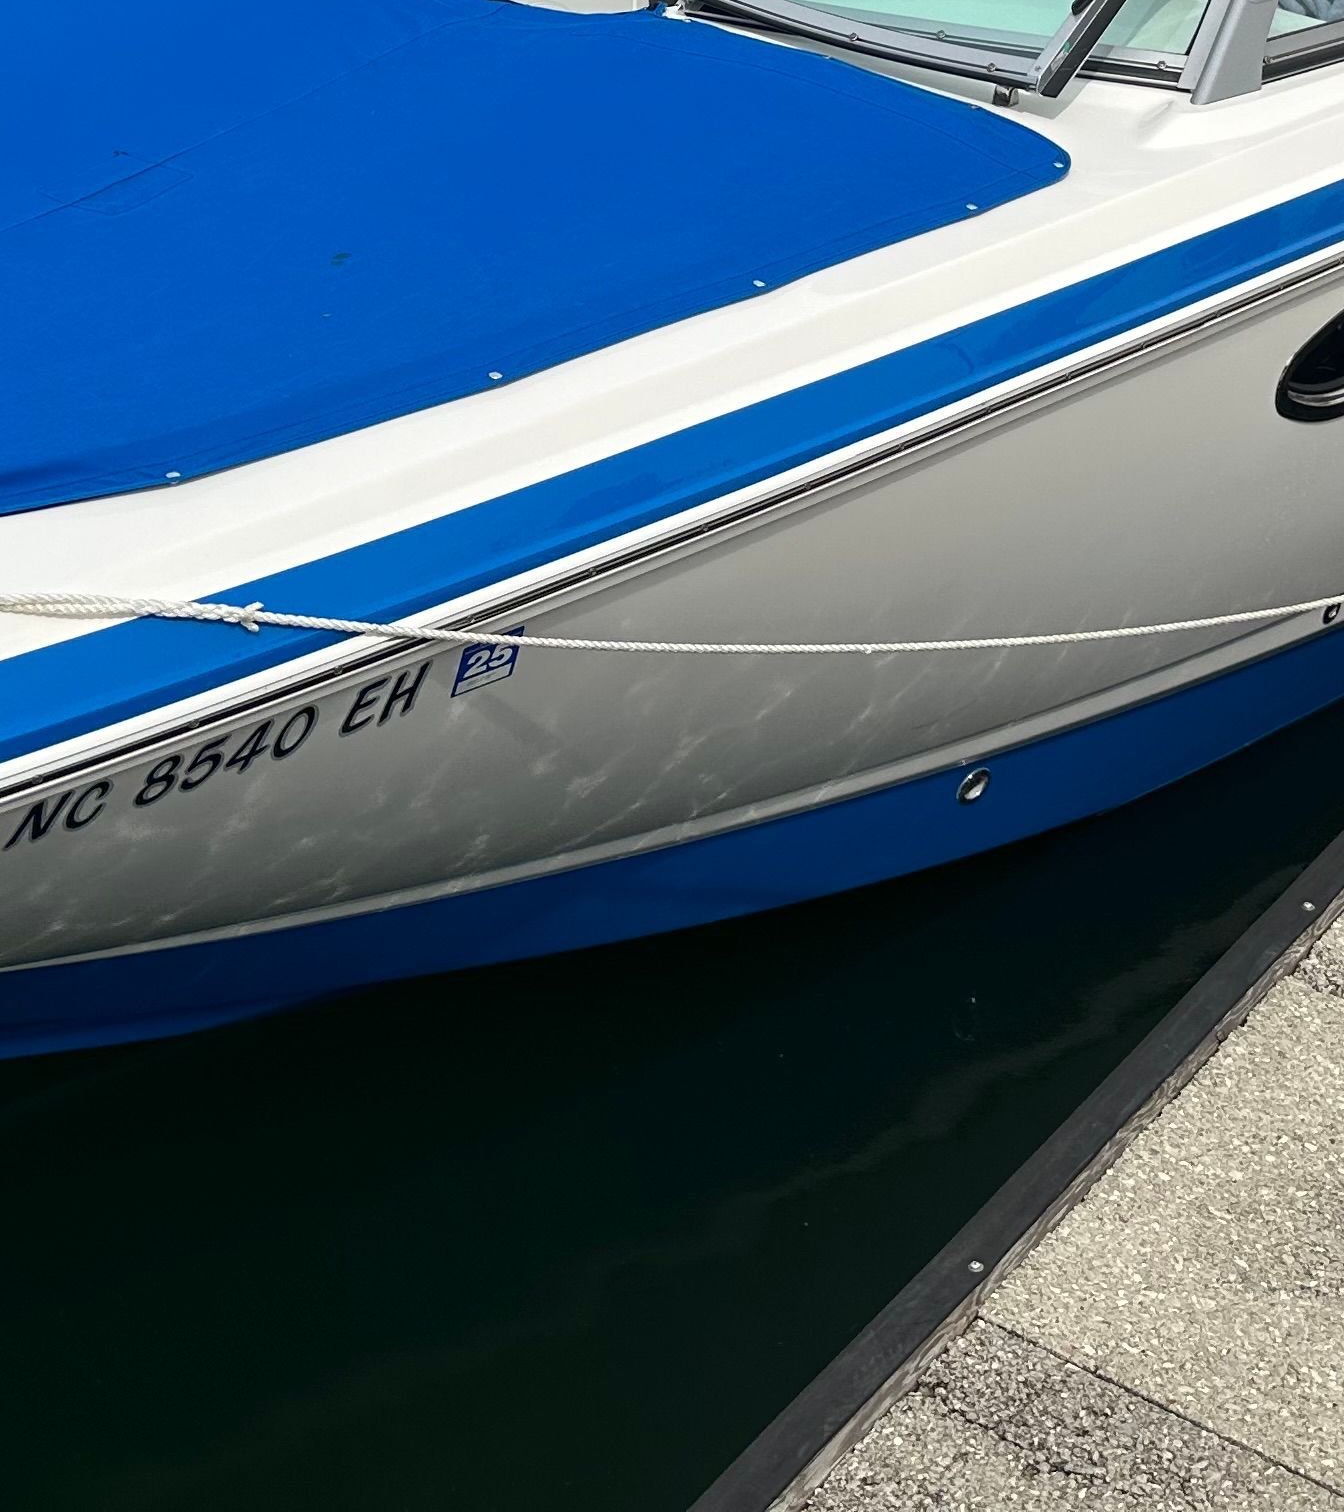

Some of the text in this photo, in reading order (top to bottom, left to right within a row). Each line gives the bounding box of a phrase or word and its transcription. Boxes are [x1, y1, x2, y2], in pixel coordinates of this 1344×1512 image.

[462, 644, 513, 679] 25
[3, 660, 434, 851] NC 8540 EH
